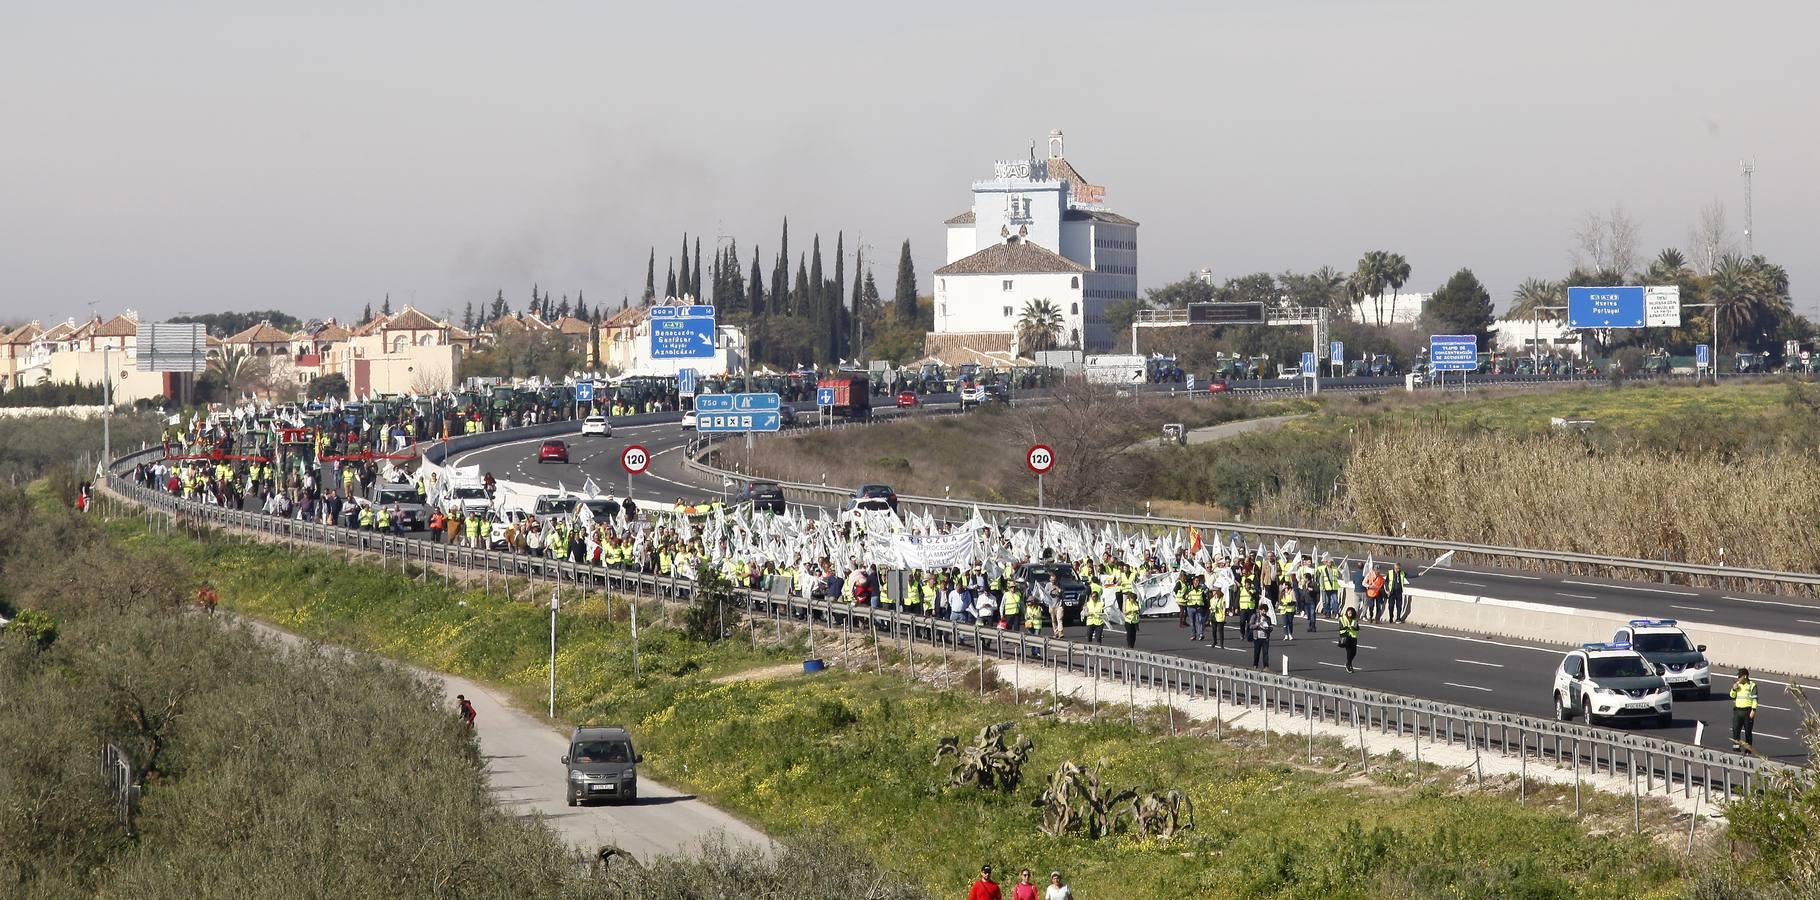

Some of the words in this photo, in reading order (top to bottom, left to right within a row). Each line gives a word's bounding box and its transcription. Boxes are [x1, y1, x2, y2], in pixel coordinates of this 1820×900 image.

[1592, 307, 1620, 315] Portugal
[627, 455, 644, 464] 120
[1032, 455, 1049, 463] 120
[899, 535, 957, 544] ARROZUA
